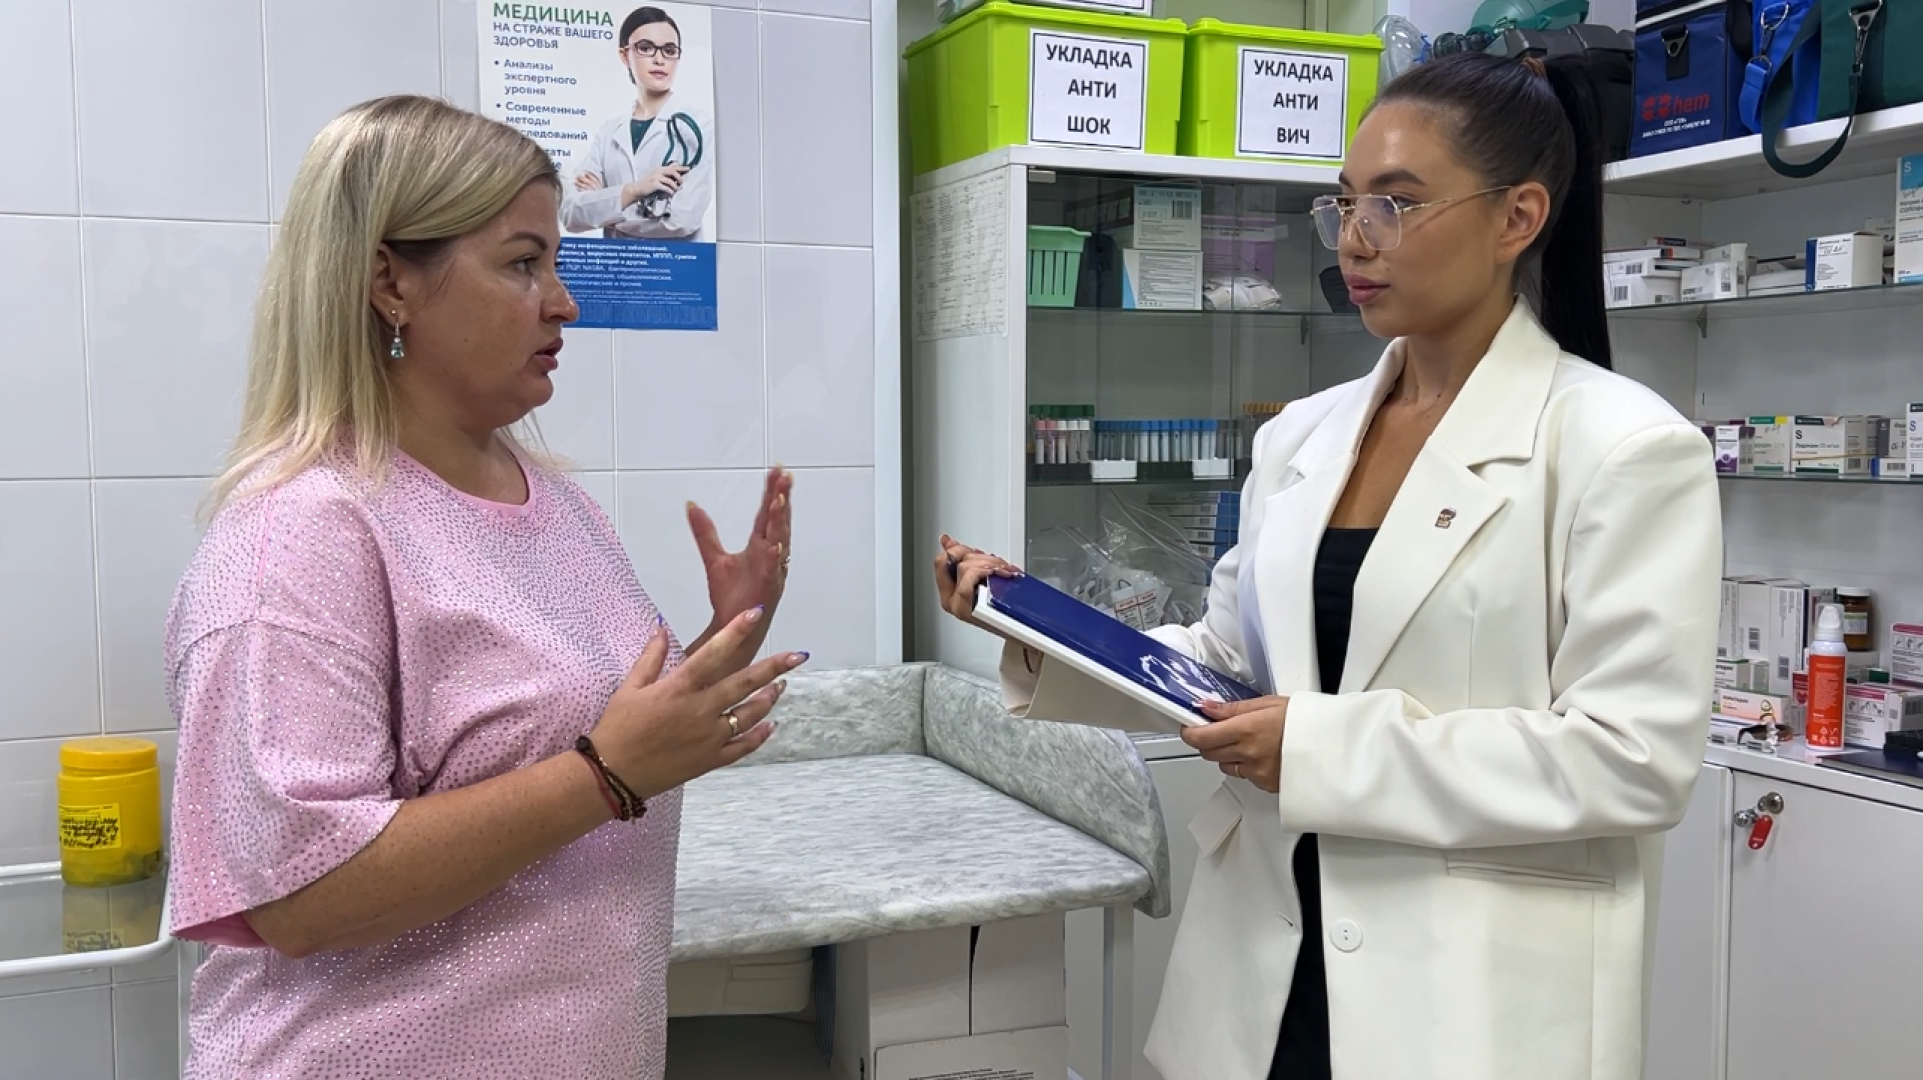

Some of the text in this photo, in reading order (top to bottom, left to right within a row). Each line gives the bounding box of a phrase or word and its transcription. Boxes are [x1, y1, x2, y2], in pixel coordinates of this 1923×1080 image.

[493, 2, 614, 27] МЕДИЦИНА
[493, 22, 614, 40] НА СТРАЖЕ ВАШЕГО
[493, 35, 559, 49] ЗДОРОВЬЯ
[504, 59, 553, 71] Анализы
[1046, 43, 1133, 70] УКЛАДКА
[504, 73, 577, 85] экспертного
[1254, 59, 1334, 84] УКЛАДКА
[504, 85, 546, 96] уровня
[1067, 79, 1117, 99] АНТИ
[505, 101, 587, 116] Современные
[1272, 92, 1319, 111] АНТИ
[505, 116, 551, 126] методы
[1067, 115, 1111, 135] ШОК
[1277, 127, 1310, 145] ВИЧ
[1795, 429, 1803, 440] S
